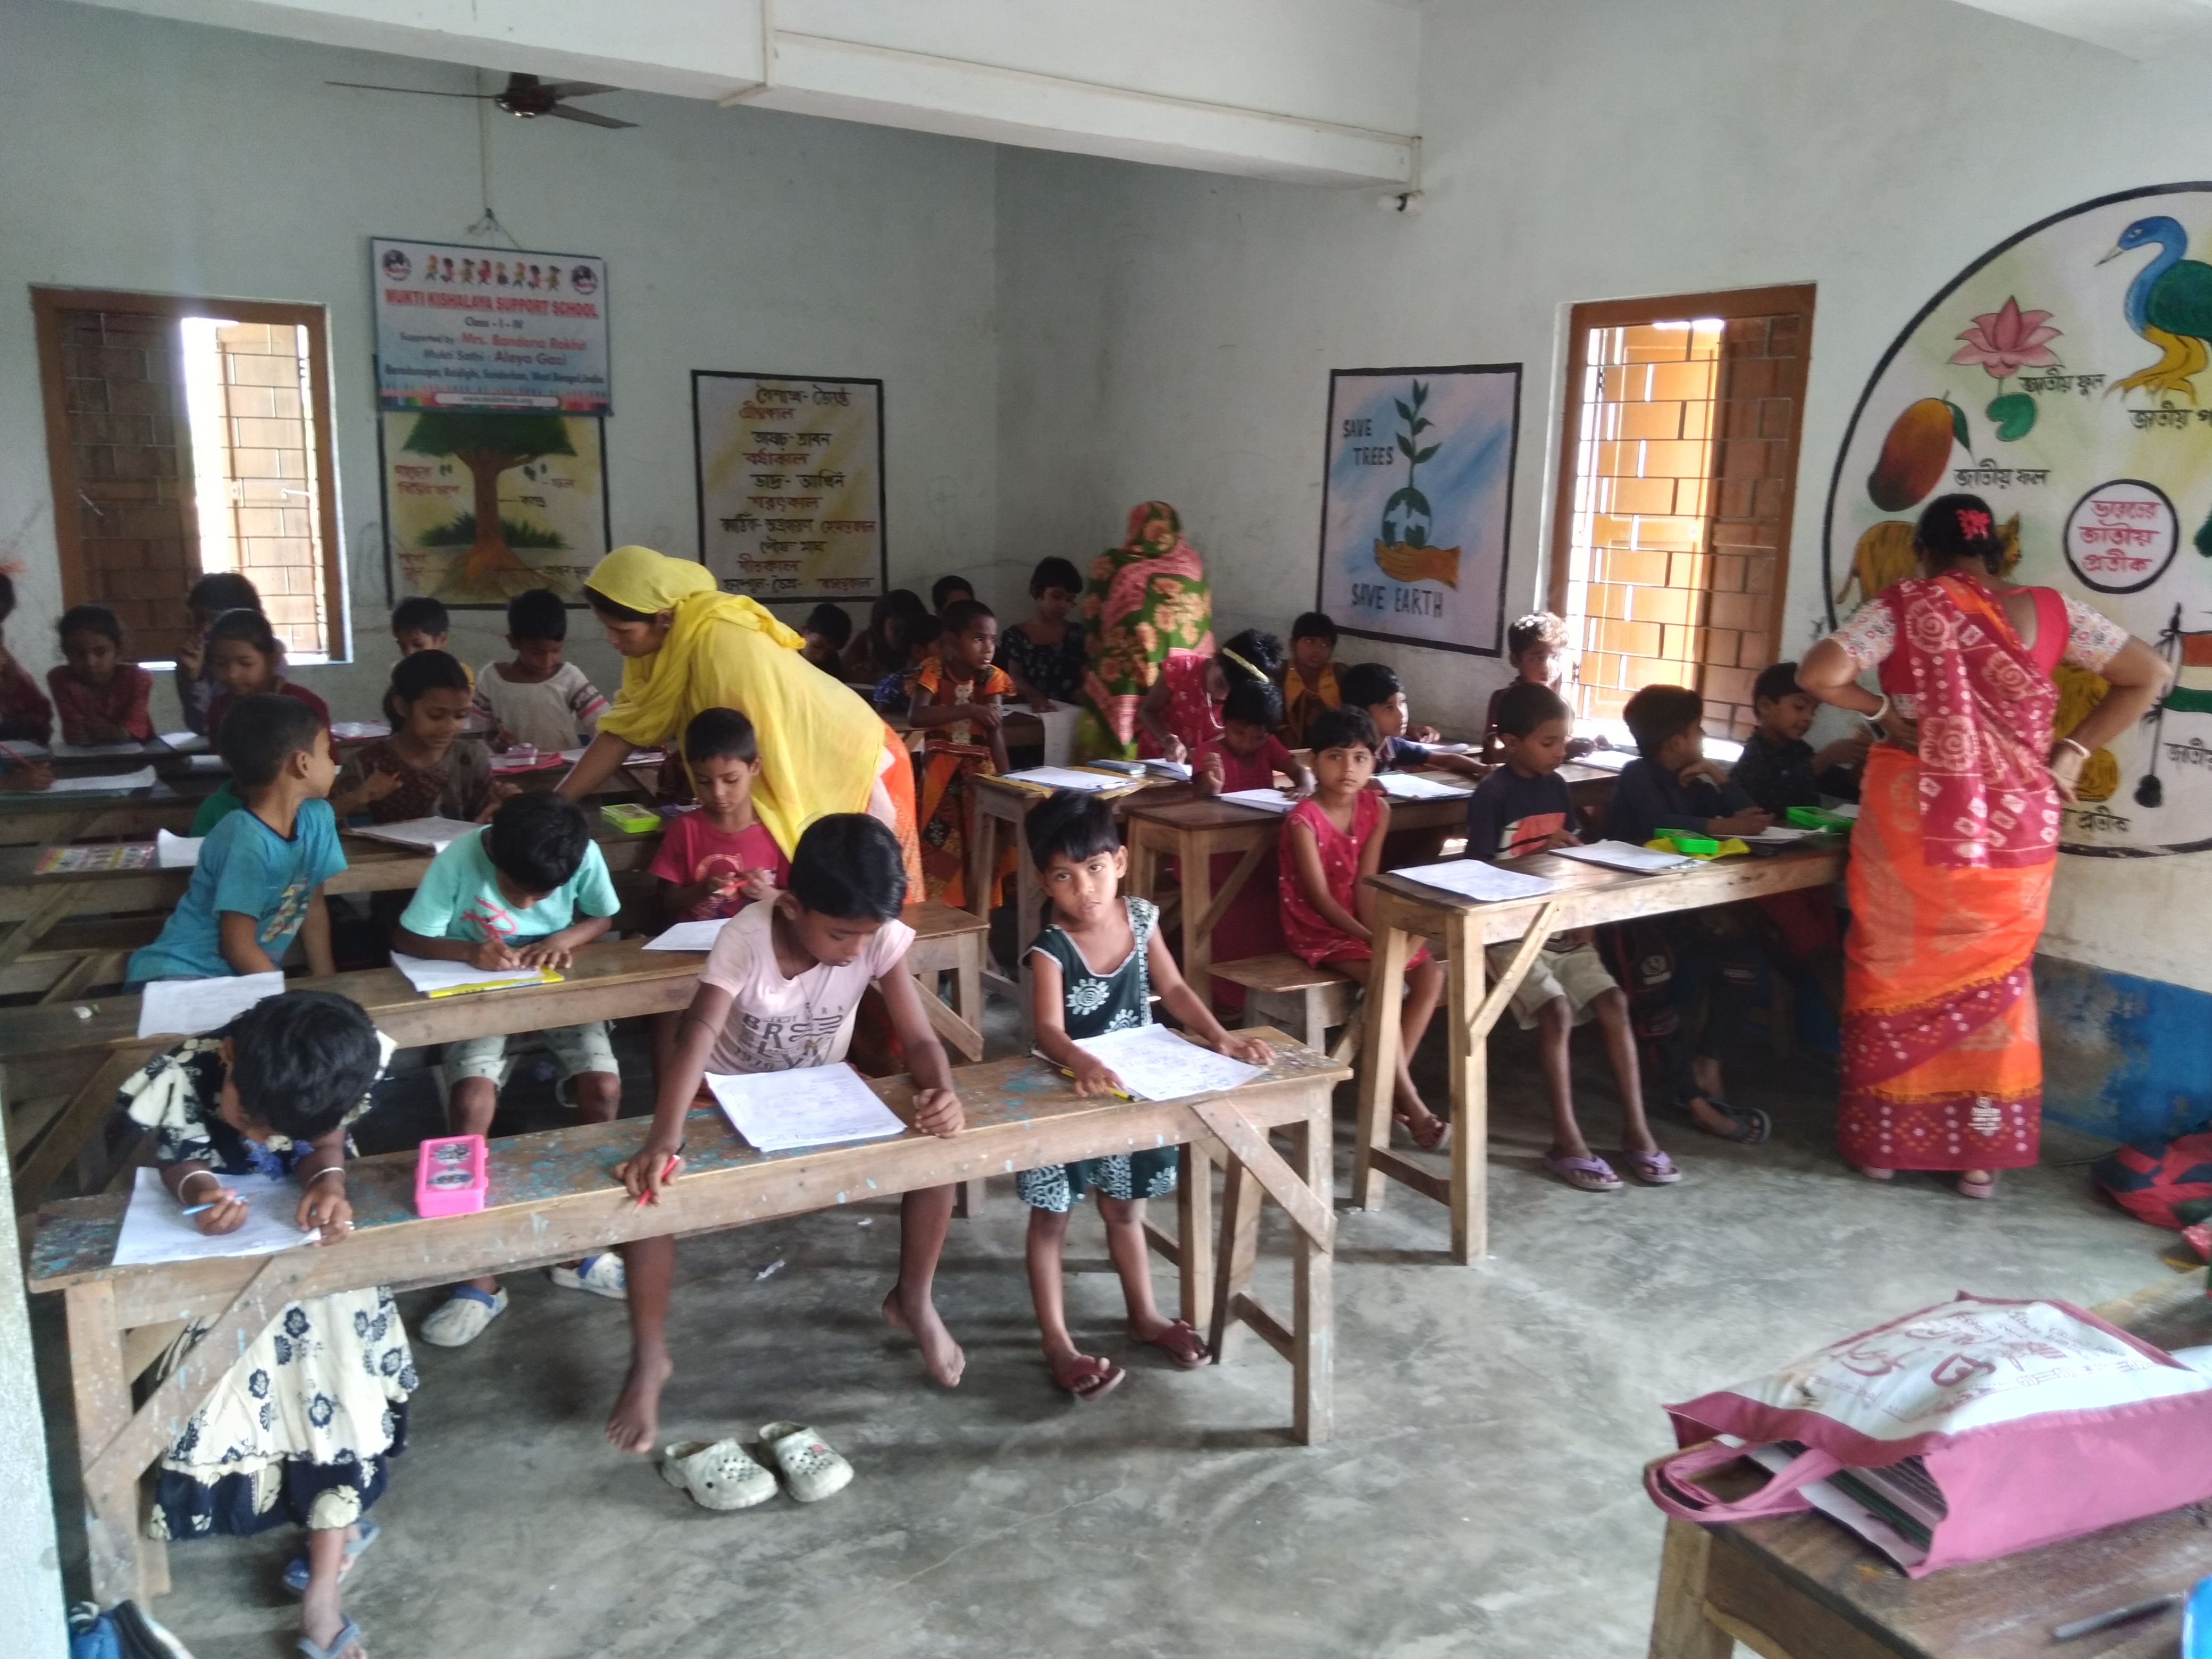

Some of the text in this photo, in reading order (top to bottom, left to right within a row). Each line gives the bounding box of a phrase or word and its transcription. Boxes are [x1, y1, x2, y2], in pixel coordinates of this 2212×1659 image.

[497, 297, 548, 315] SUPPORT
[552, 300, 599, 319] SCHOOL
[1343, 418, 1372, 438] SAVE
[1353, 446, 1394, 466] TREES
[1954, 458, 2014, 490] জাতীয়
[2078, 519, 2160, 547] জাতীয়
[2083, 548, 2154, 572] প্রতীক
[1352, 583, 1444, 618] SAVE EARTH
